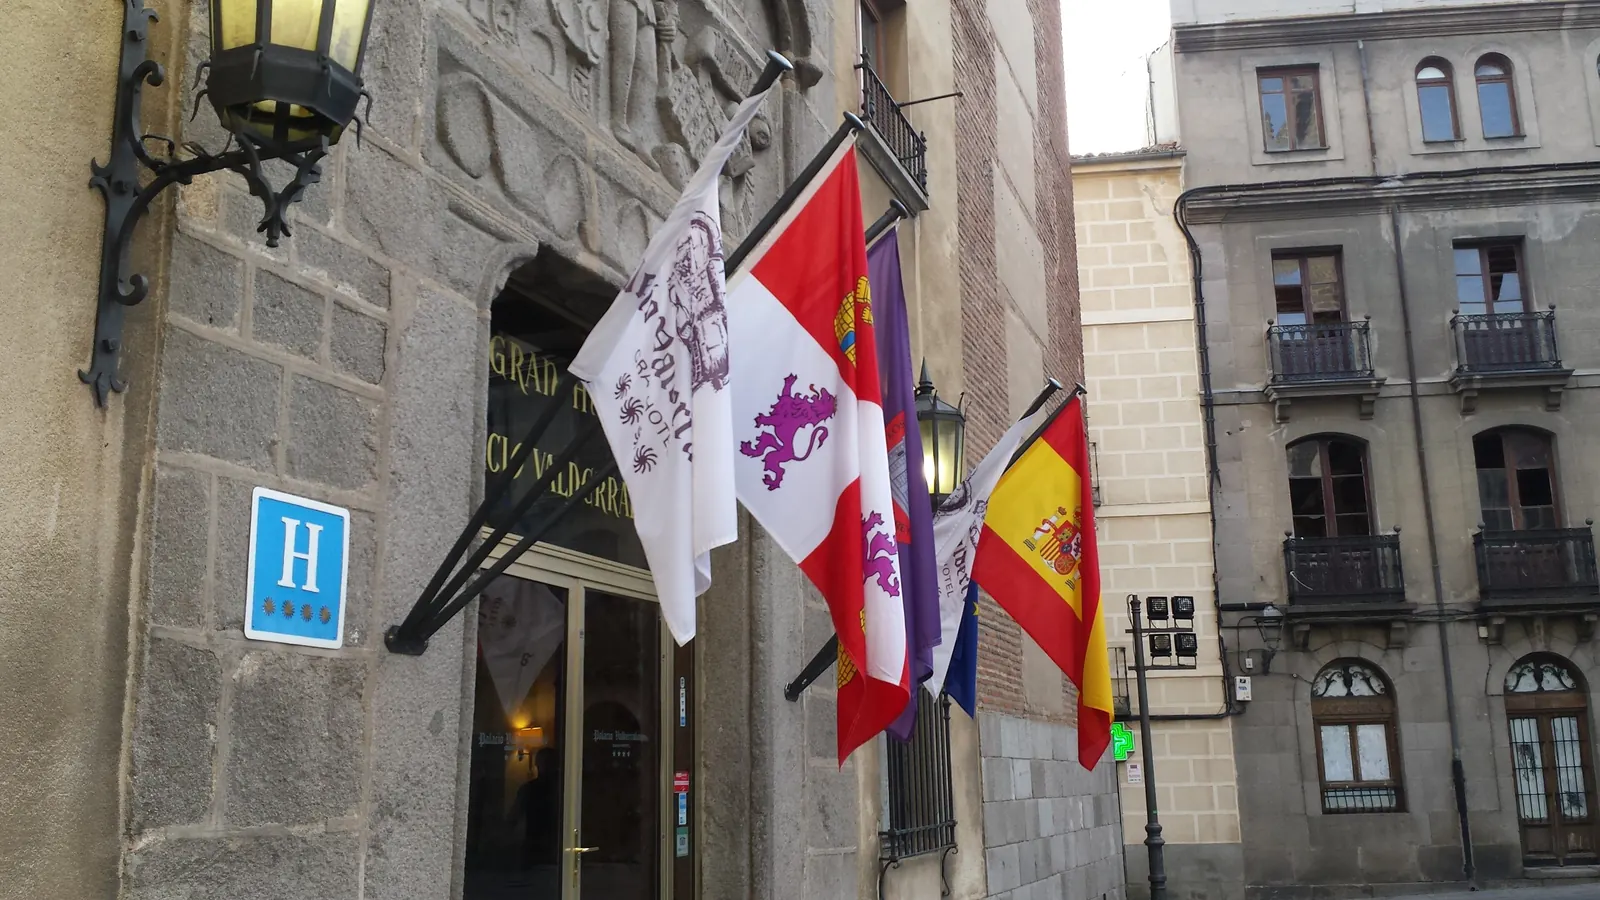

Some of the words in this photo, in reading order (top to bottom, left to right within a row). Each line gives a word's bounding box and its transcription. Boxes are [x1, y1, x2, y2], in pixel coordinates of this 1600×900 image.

[572, 382, 598, 416] H
[277, 516, 324, 593] H
[942, 563, 954, 598] OTEL
